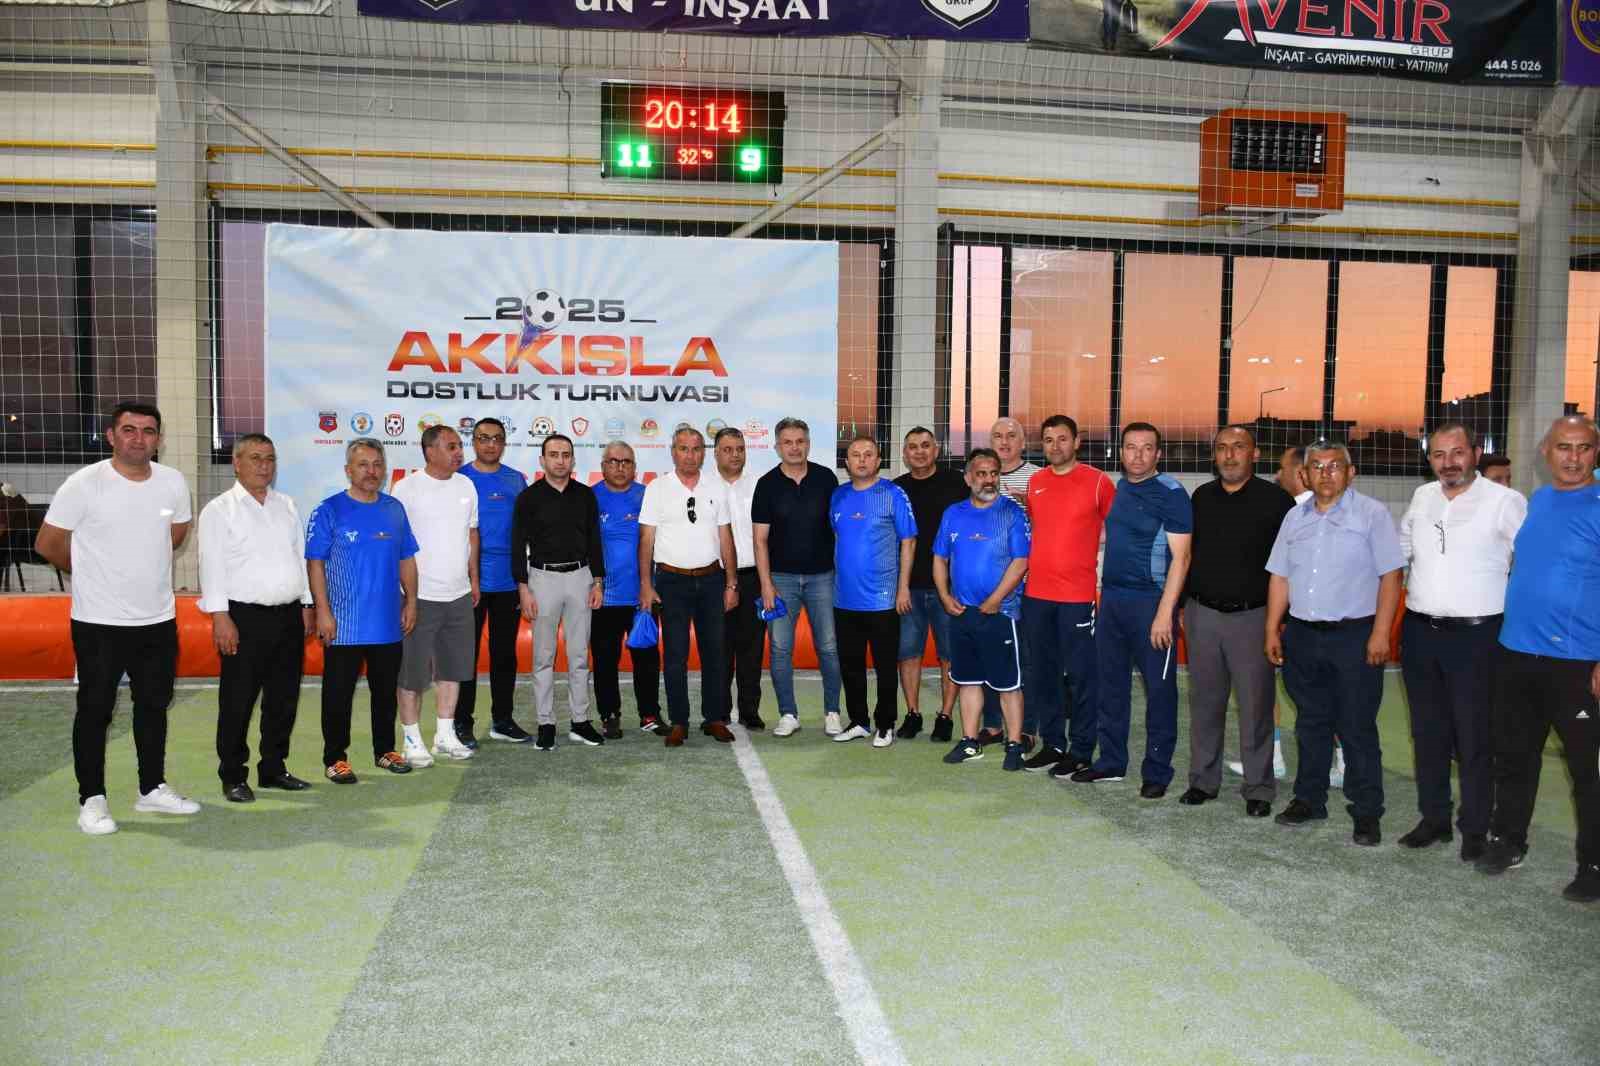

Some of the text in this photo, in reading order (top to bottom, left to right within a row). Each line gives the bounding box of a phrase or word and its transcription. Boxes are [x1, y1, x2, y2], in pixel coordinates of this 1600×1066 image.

[1264, 46, 1304, 64] İNŞAAT
[1315, 52, 1397, 70] GAYRİMENKUL
[1406, 58, 1449, 74] YATIRIM
[1410, 46, 1451, 57] GRUP
[1485, 60, 1542, 71] 444 5 026
[645, 100, 741, 133] 20:14
[618, 144, 652, 168] 11
[740, 148, 762, 172] 9
[386, 381, 729, 403] DOSTLUK TURNUVASI
